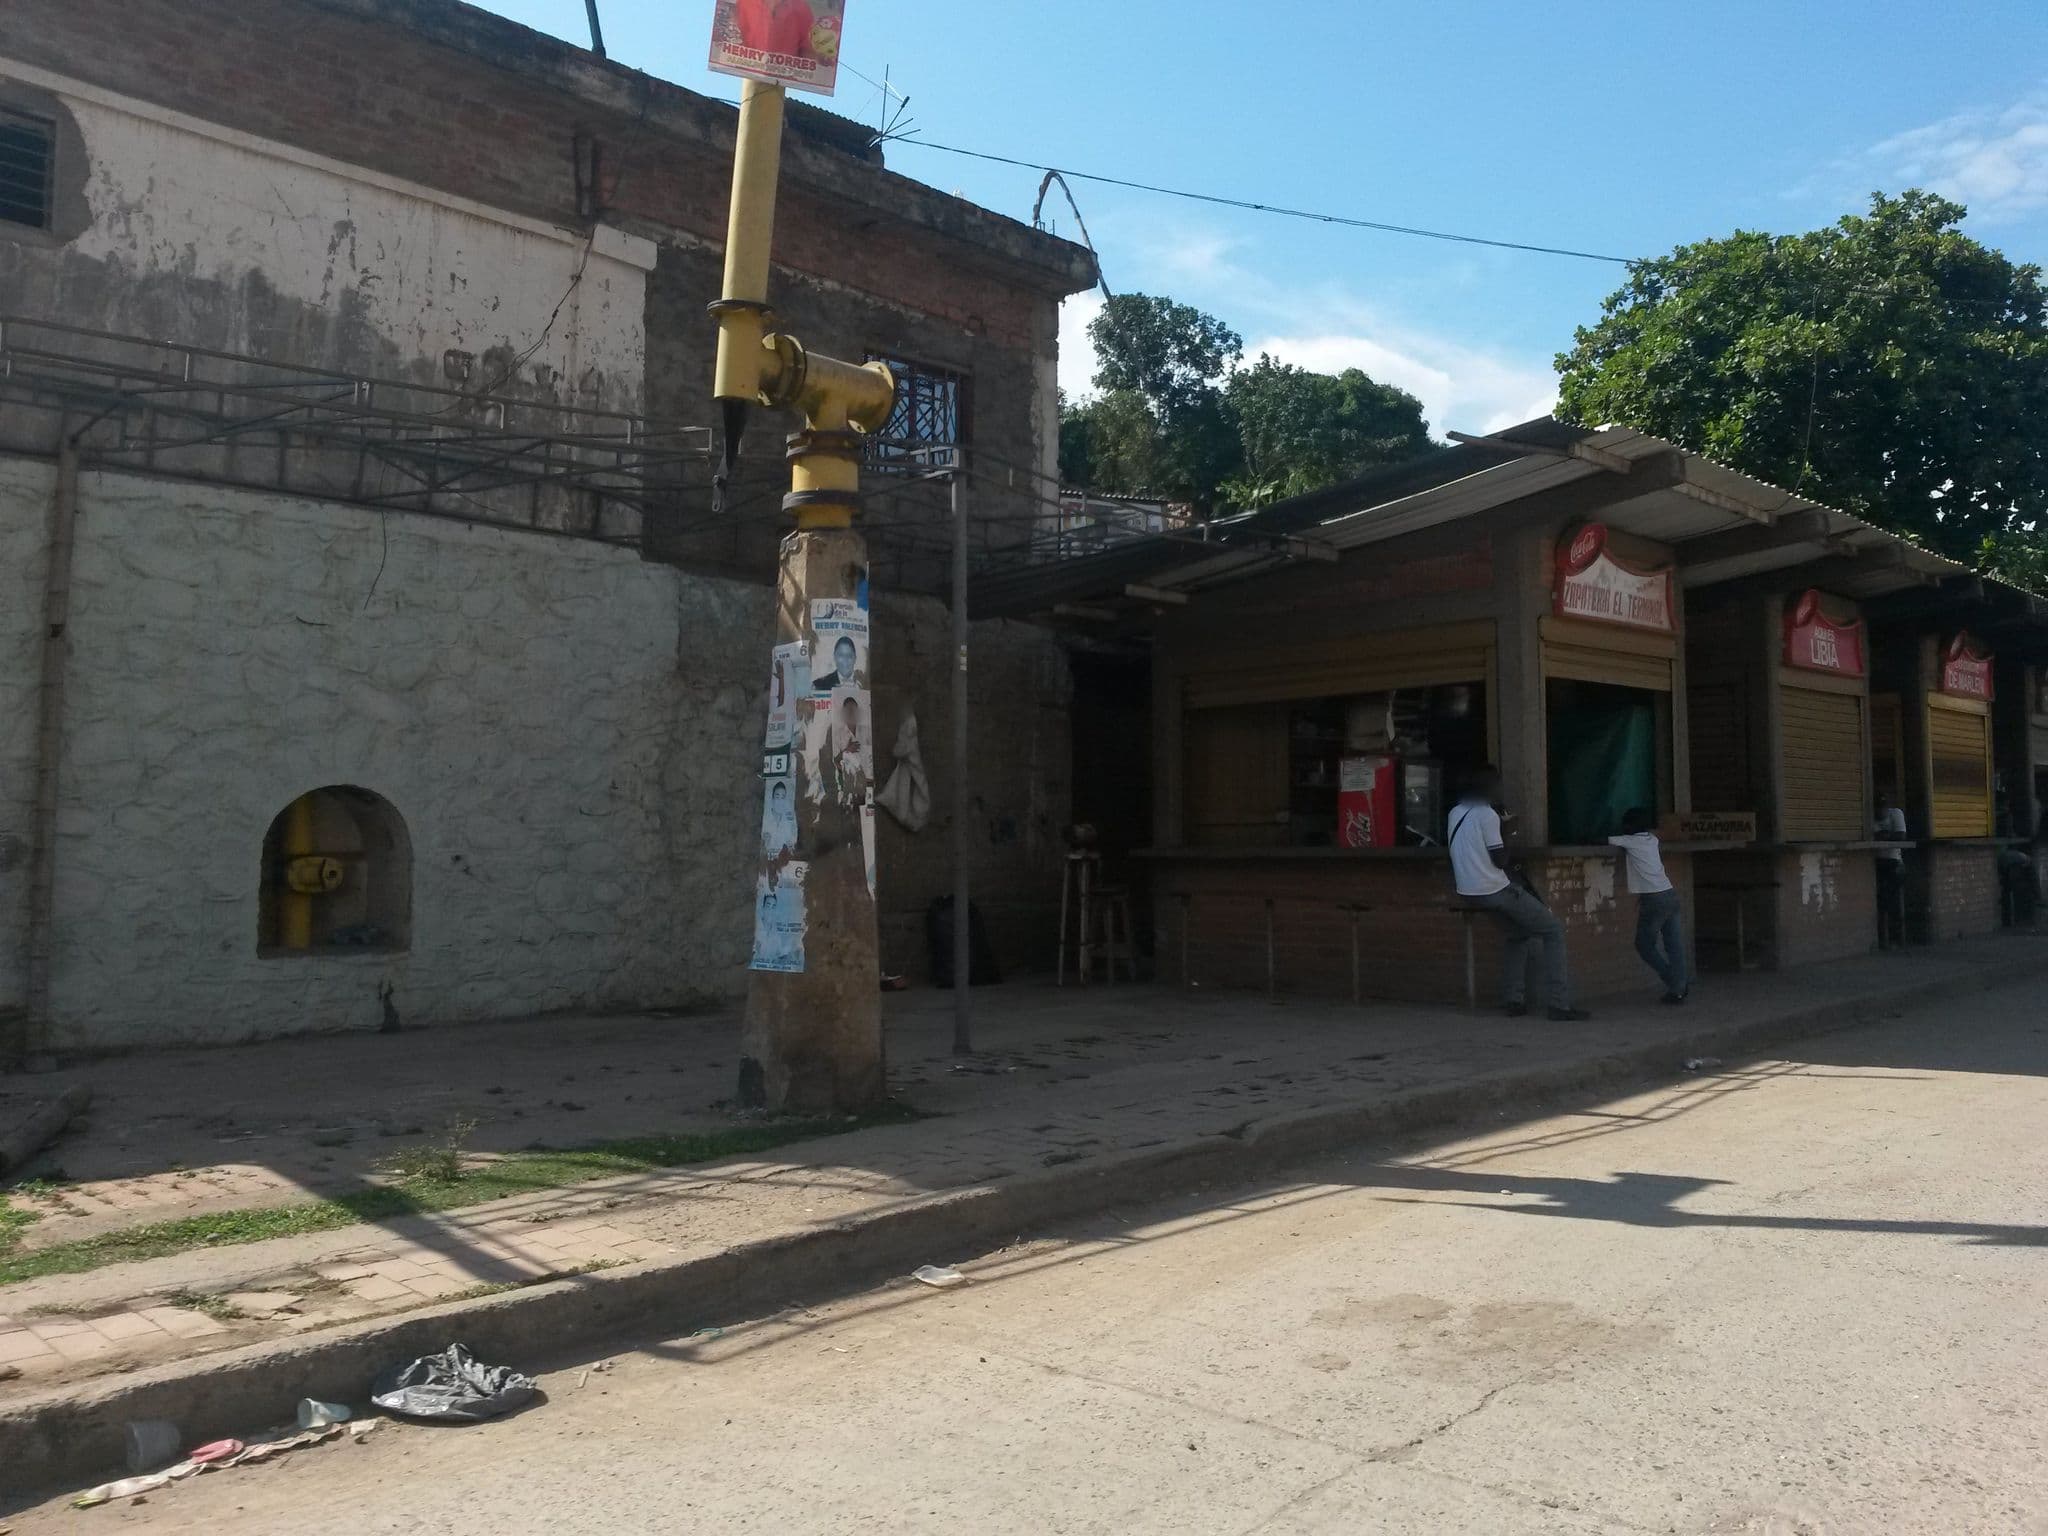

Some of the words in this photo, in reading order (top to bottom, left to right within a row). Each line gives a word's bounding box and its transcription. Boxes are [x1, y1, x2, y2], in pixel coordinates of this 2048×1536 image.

[722, 42, 764, 62] HENRY
[766, 53, 817, 72] TORRES
[1613, 591, 1623, 616] EL
[799, 644, 808, 657] 6
[1810, 638, 1840, 668] LIBIA
[775, 758, 783, 770] 5
[1679, 820, 1752, 834] MAZAMORRA
[794, 866, 803, 879] 6
